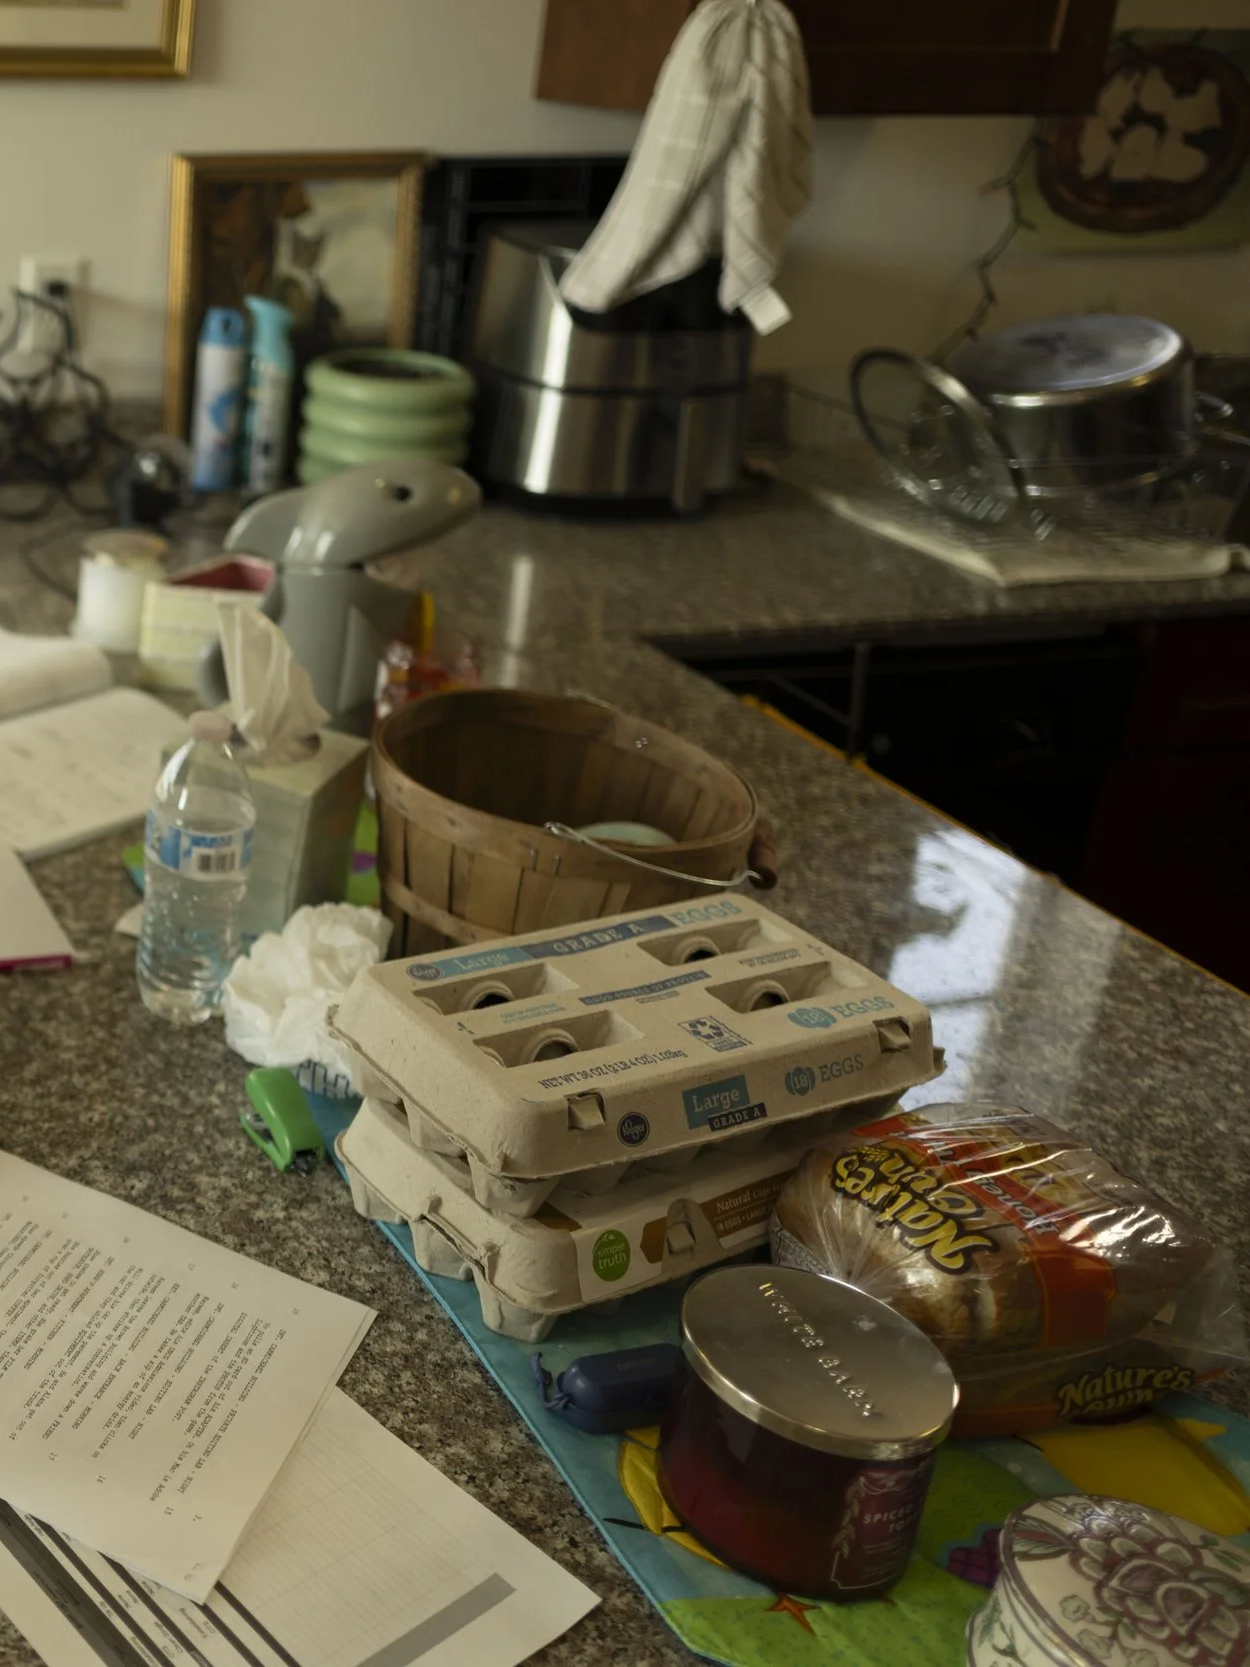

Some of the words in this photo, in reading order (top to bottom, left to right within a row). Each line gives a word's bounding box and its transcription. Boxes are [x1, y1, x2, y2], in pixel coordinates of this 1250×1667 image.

[453, 950, 510, 970] Large
[552, 926, 624, 953] GRADE
[629, 922, 645, 935] A
[669, 901, 744, 925] EGGS
[833, 994, 895, 1021] EGGS
[538, 1078, 561, 1089] NET
[561, 1073, 580, 1085] WT
[589, 1067, 606, 1077] OZ
[614, 1061, 631, 1070] LB
[634, 1054, 656, 1066] OZ)
[819, 1054, 865, 1083] EGGS
[692, 1087, 740, 1113] Large
[713, 1111, 750, 1129] GRADE
[752, 1108, 762, 1117] A
[716, 1190, 751, 1214] Natural
[965, 1169, 1060, 1234] Honey
[598, 1241, 626, 1259] simple
[598, 1251, 627, 1270] truth
[816, 1355, 880, 1418] BARN
[1057, 1363, 1193, 1417] Nature's
